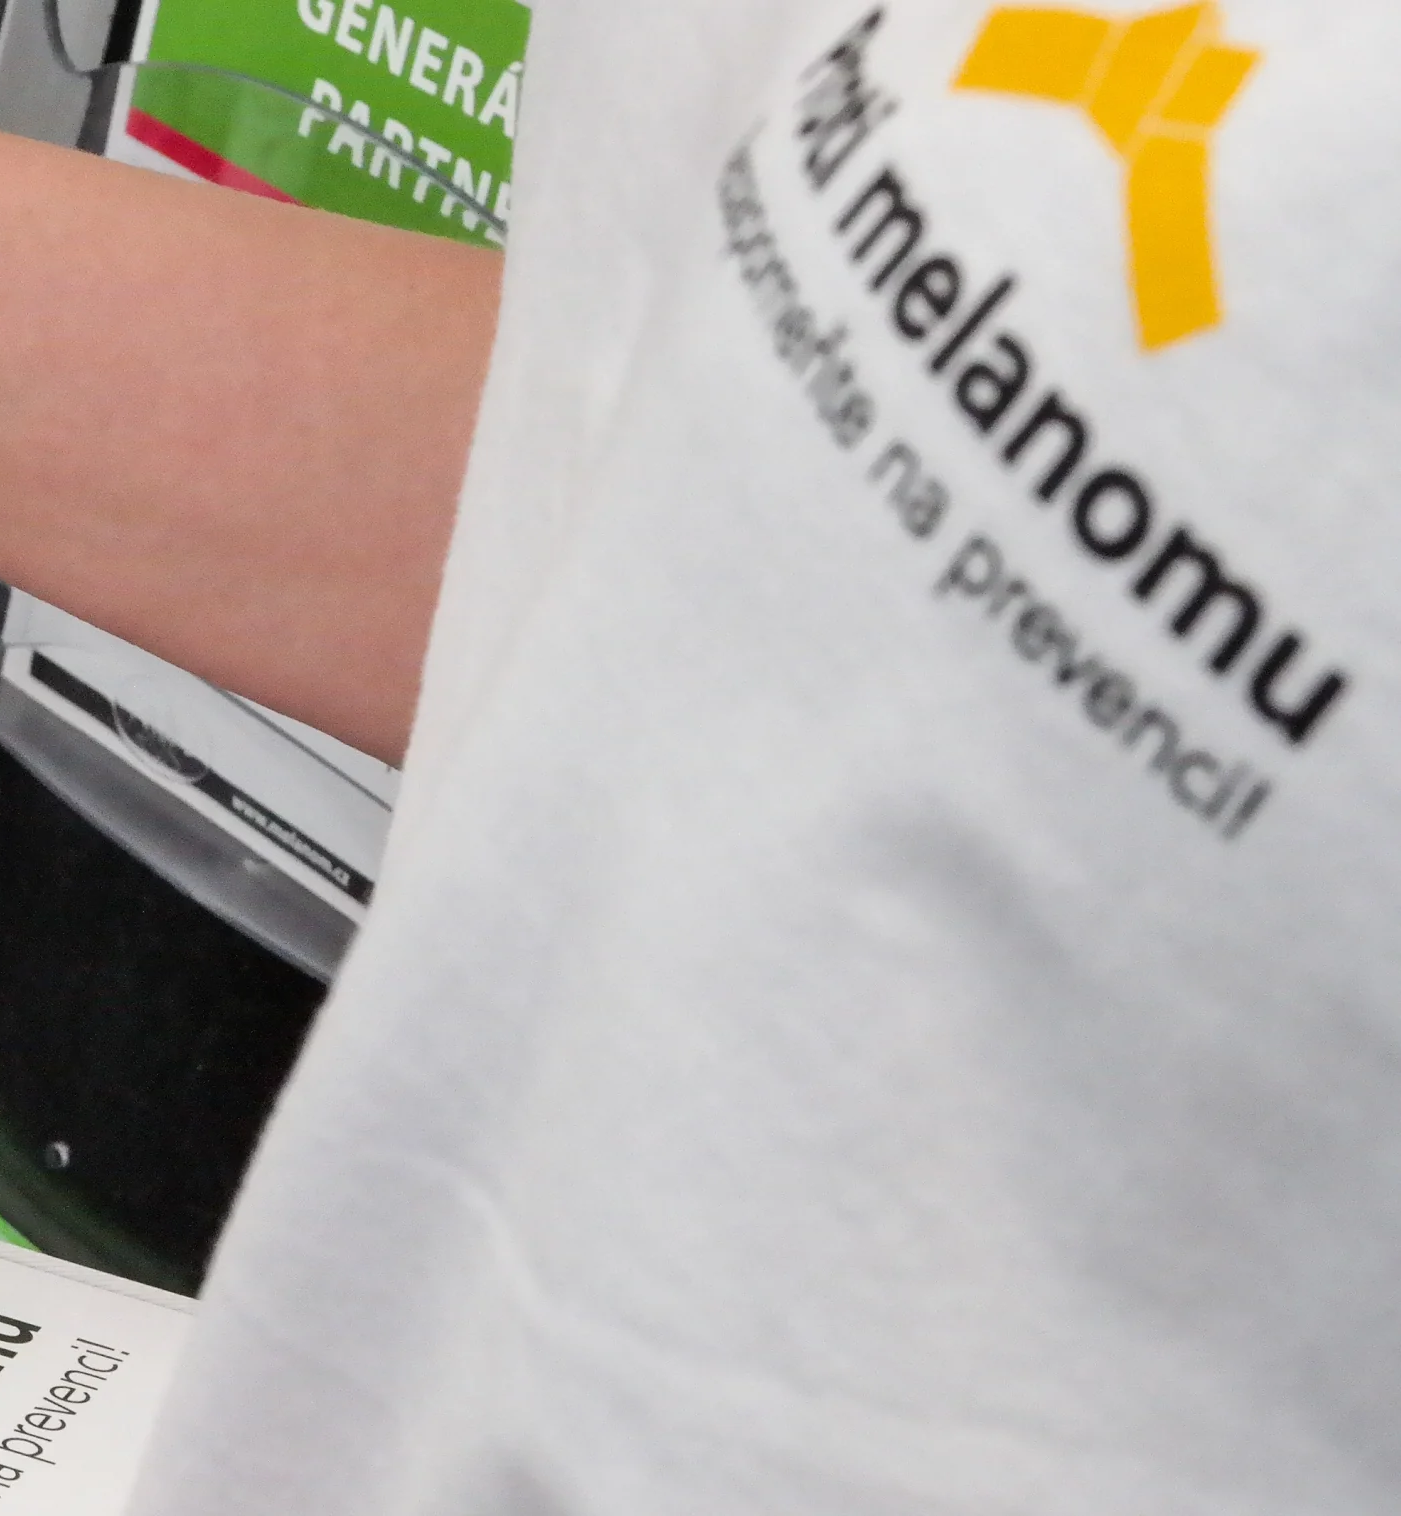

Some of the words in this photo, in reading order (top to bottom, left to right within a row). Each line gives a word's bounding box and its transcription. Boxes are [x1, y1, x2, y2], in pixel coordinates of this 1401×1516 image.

[833, 162, 1348, 748] melanomu
[867, 438, 950, 539] na
[932, 533, 1272, 840] prevenci!
